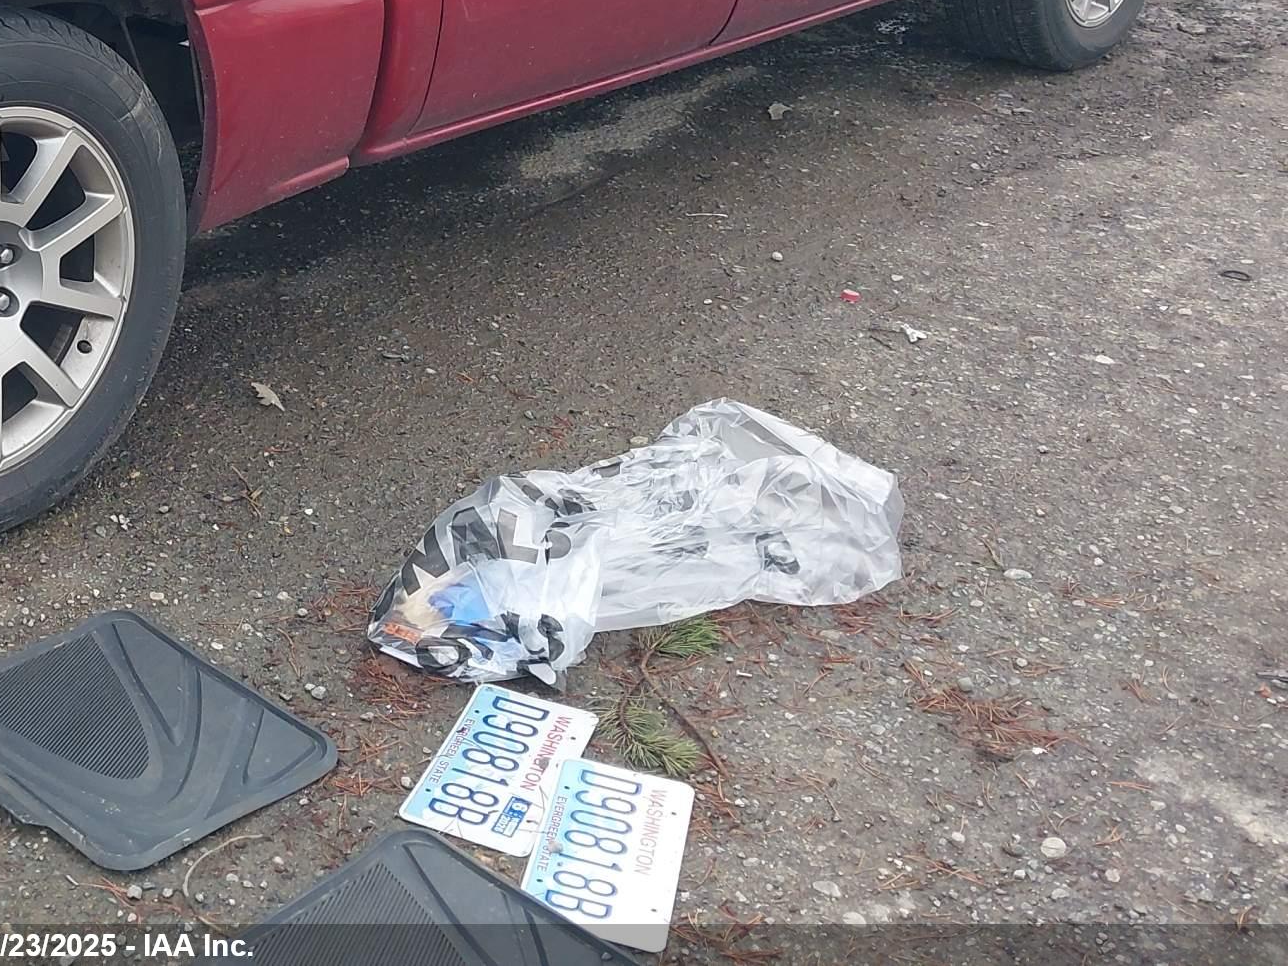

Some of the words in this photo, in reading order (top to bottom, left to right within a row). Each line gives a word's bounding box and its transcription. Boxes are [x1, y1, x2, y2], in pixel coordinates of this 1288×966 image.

[428, 695, 550, 826] D90818B
[429, 760, 450, 783] STATE
[444, 718, 475, 760] EVERGREEN
[520, 714, 572, 791] WASHINGTON
[545, 796, 568, 846] EVERGREEN
[545, 769, 642, 919] D90818B
[634, 789, 668, 875] WASHINGTON
